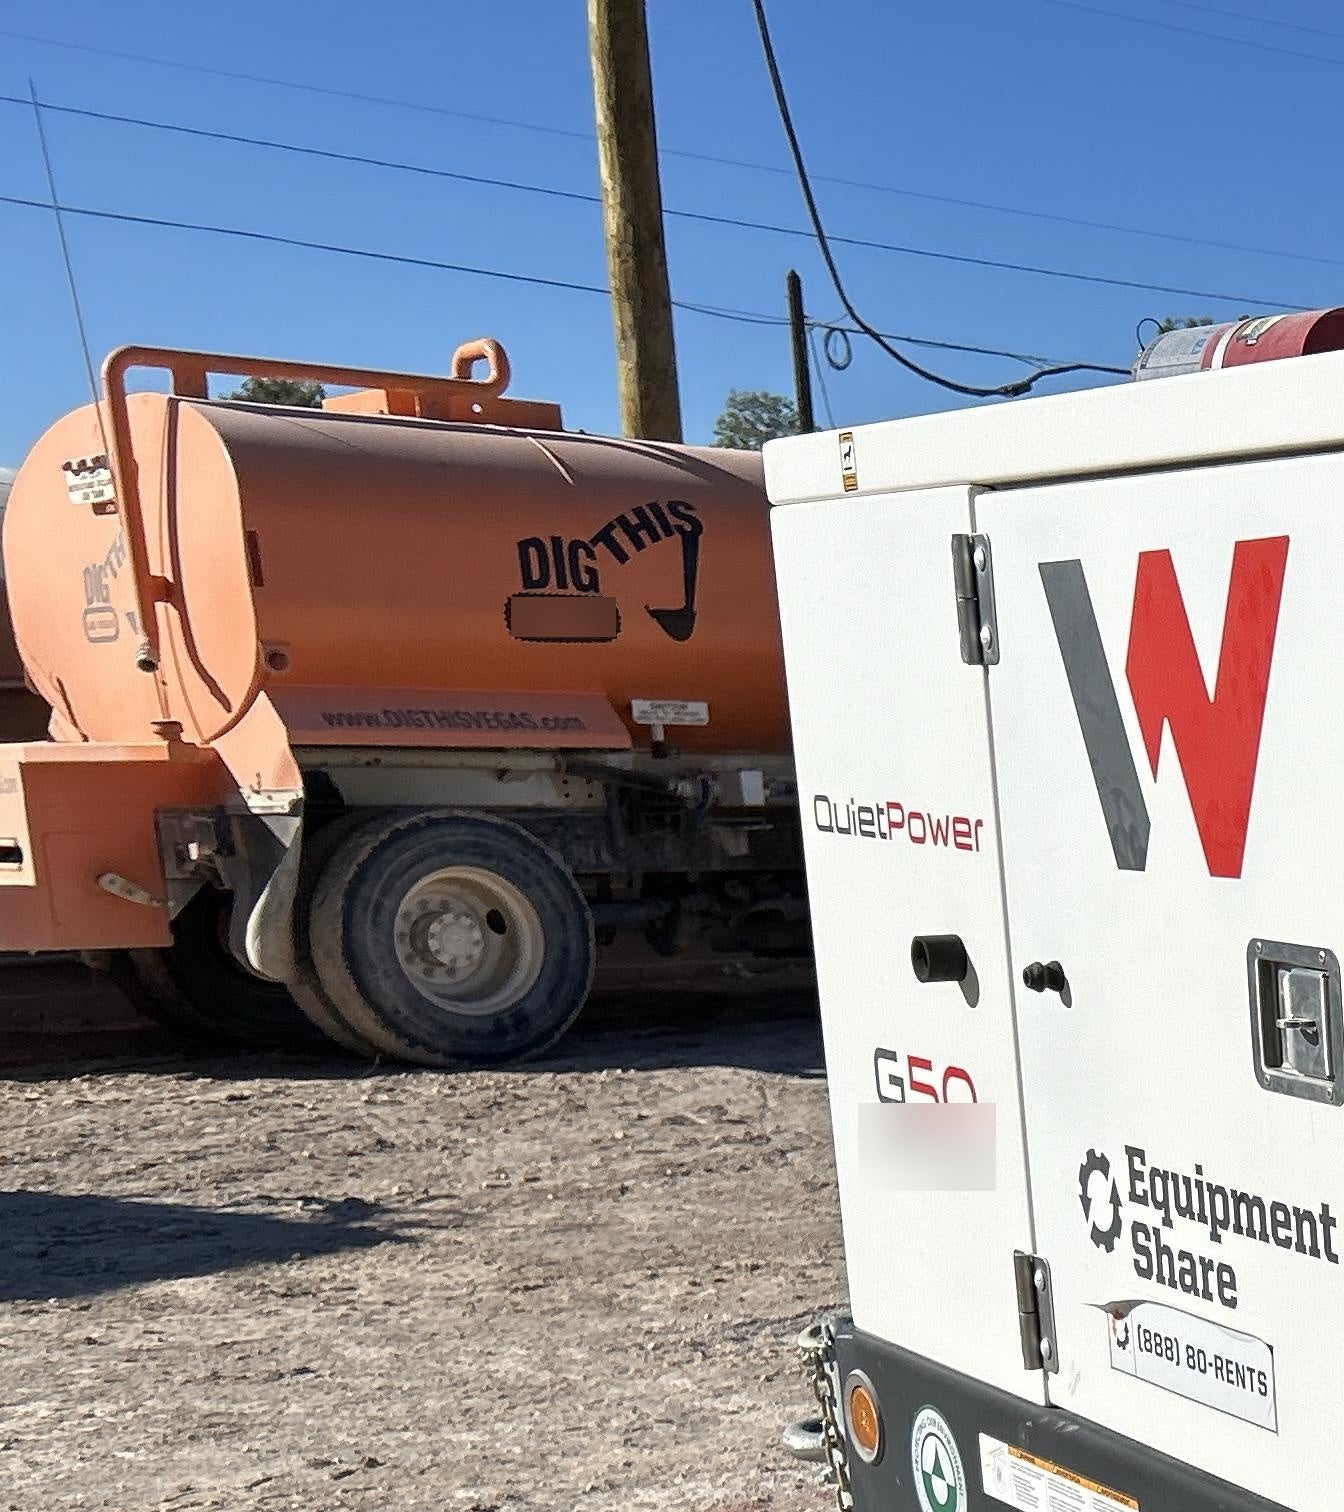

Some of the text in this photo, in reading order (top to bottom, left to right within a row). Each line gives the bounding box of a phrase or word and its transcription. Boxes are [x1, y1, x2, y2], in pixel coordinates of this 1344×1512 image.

[518, 500, 704, 593] DIG THIS
[813, 794, 984, 852] QuietPower
[1124, 1144, 1339, 1265] Equipment
[1131, 1220, 1238, 1310] Share
[1137, 1324, 1268, 1397] (888) 80-RENTS
